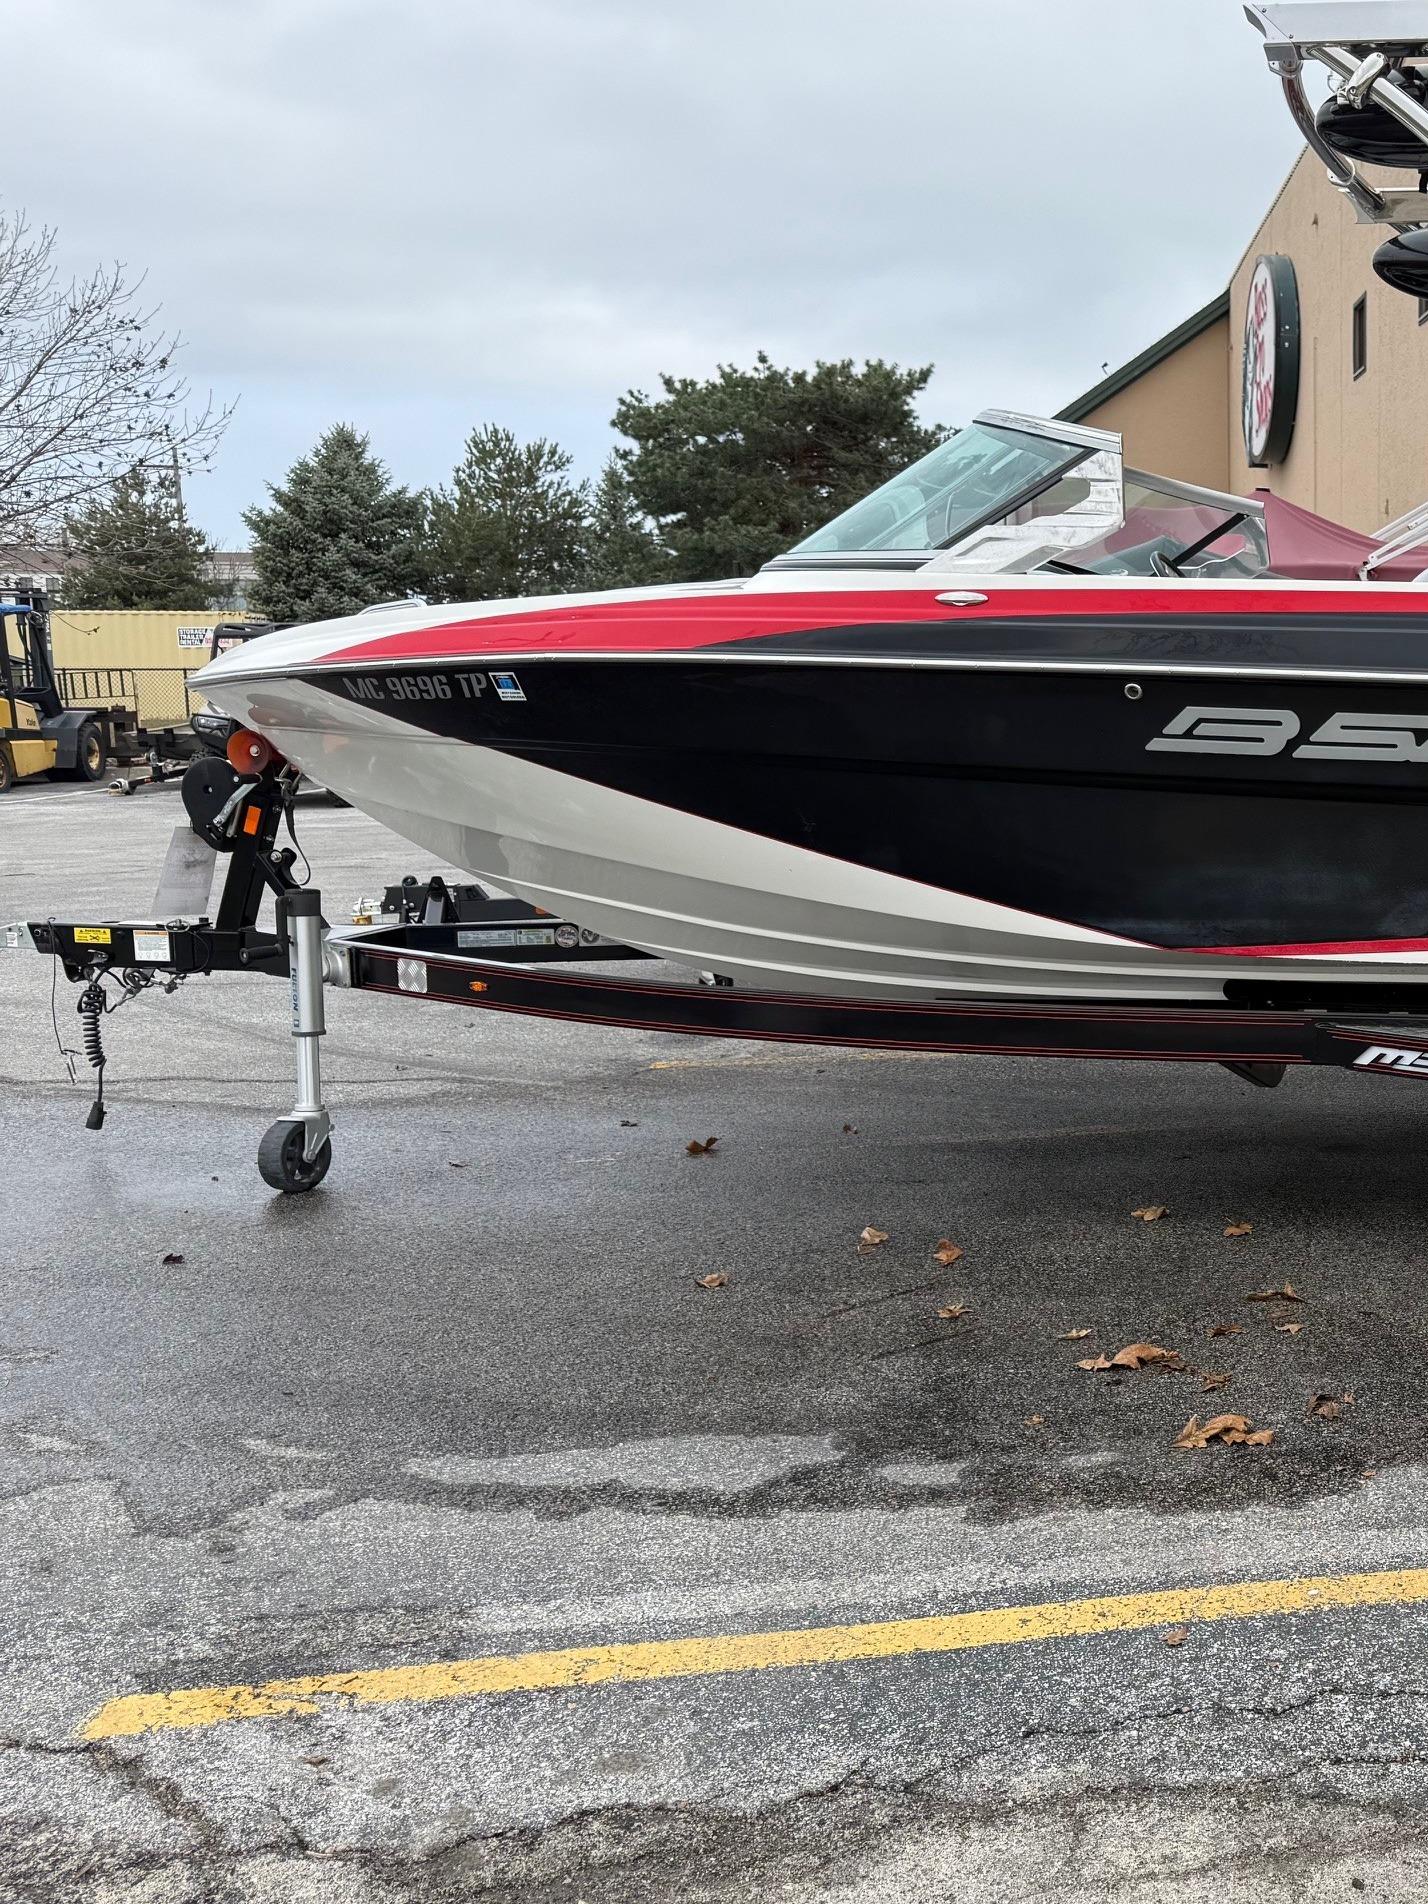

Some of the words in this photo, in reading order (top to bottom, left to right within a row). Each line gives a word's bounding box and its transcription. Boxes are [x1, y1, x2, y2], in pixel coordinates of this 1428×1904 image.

[343, 677, 384, 700] MC
[386, 675, 452, 700] 9696
[455, 673, 487, 698] TP
